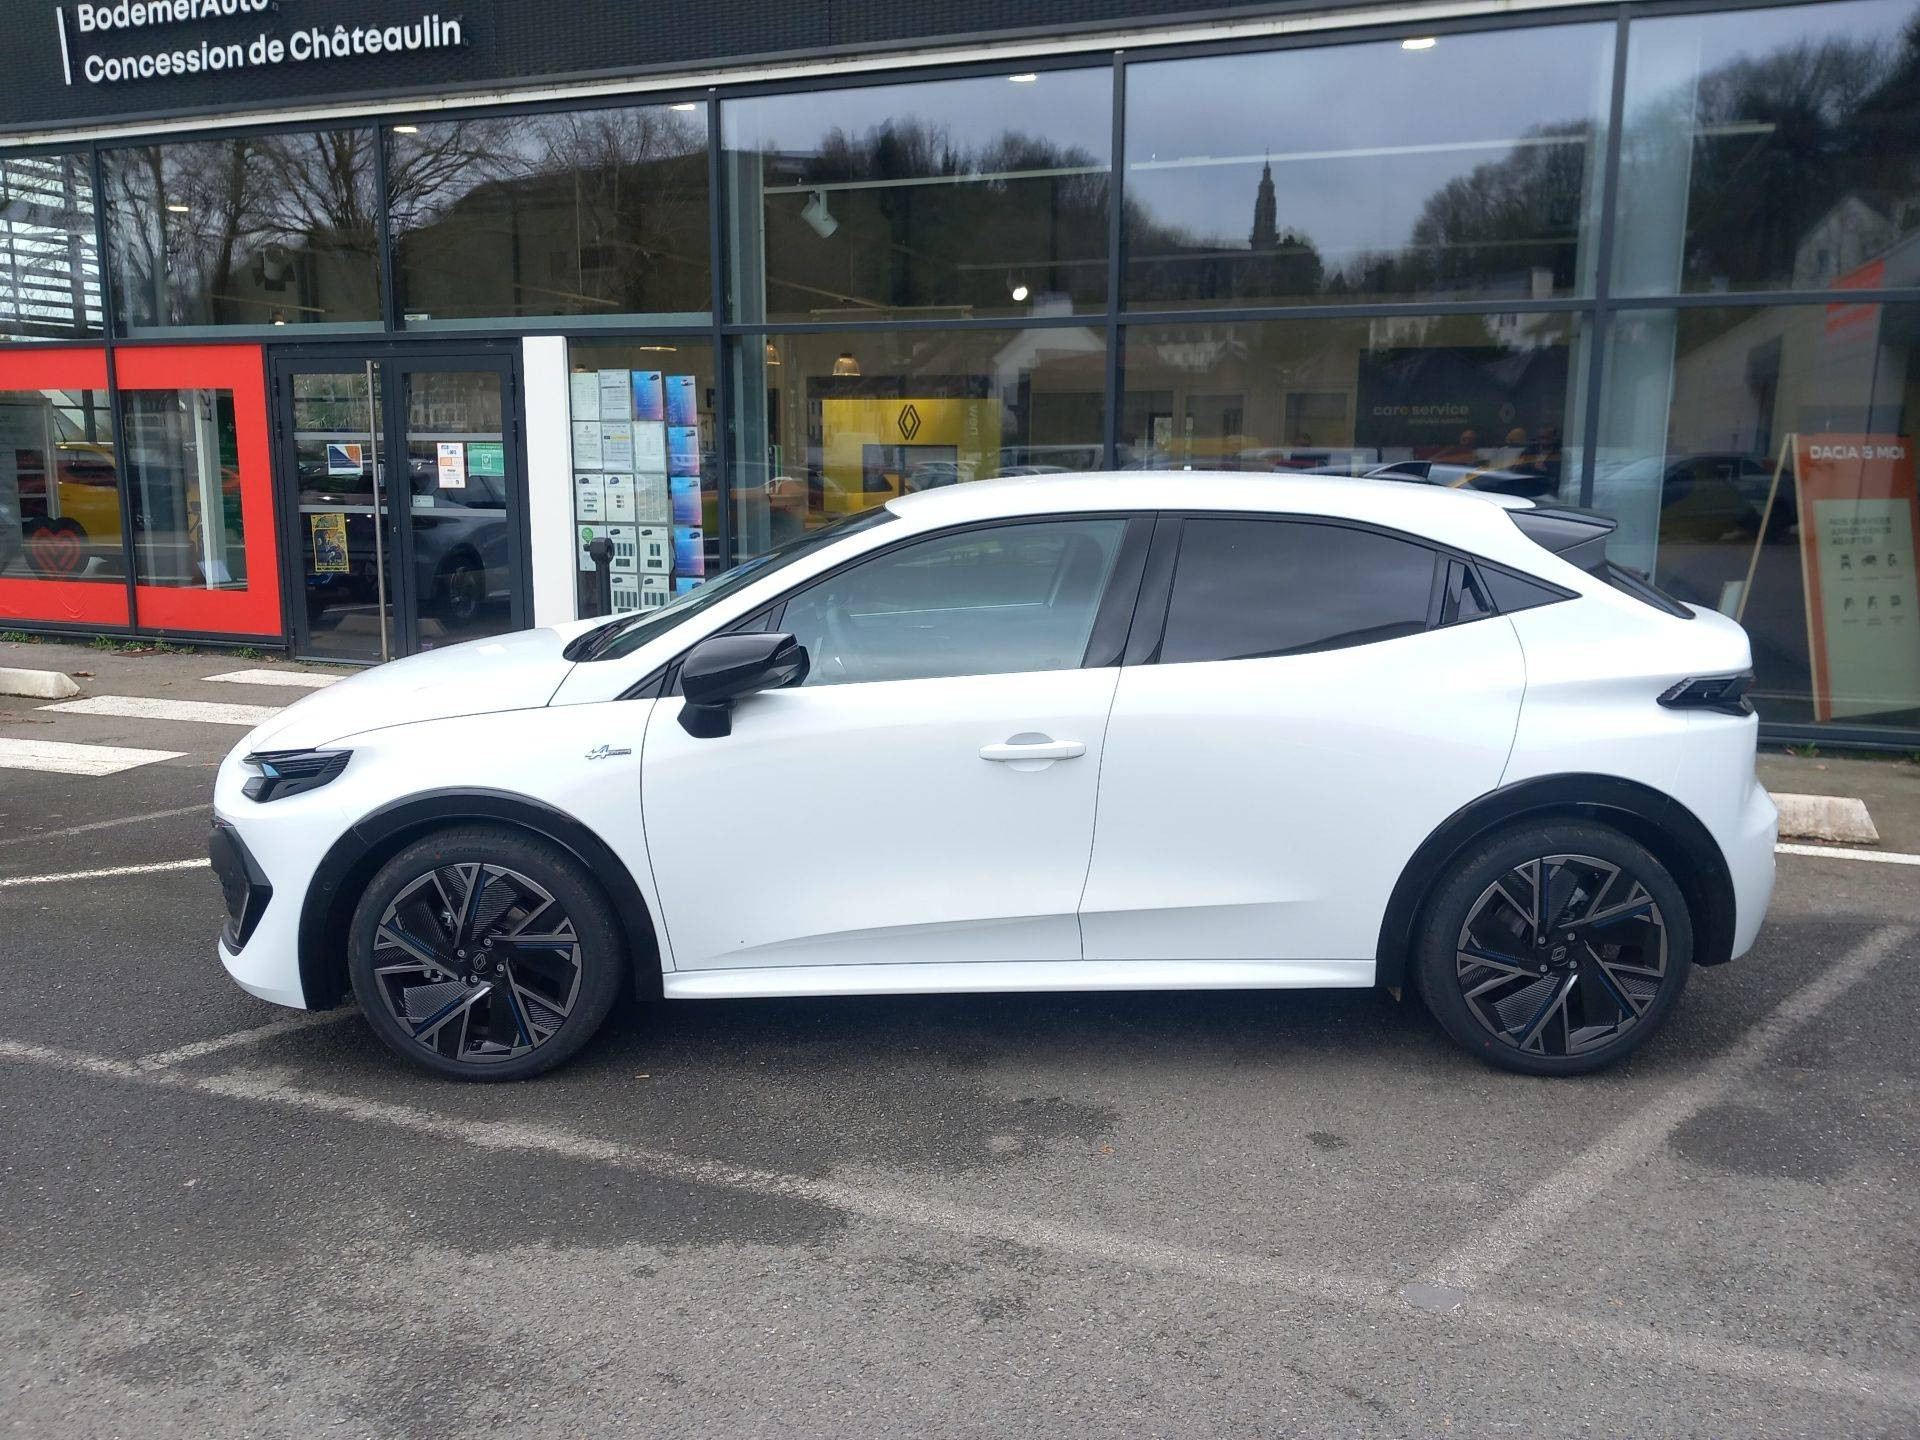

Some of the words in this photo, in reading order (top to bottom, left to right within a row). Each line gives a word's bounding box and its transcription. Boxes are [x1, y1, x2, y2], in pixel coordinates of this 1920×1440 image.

[84, 40, 244, 84] Concession
[248, 33, 285, 66] de
[289, 14, 462, 62] Châteaulin
[1373, 405, 1409, 416] care
[1411, 402, 1470, 416] service
[1809, 445, 1859, 460] DACIA
[1876, 445, 1906, 460] MOI
[434, 846, 499, 858] coContact
